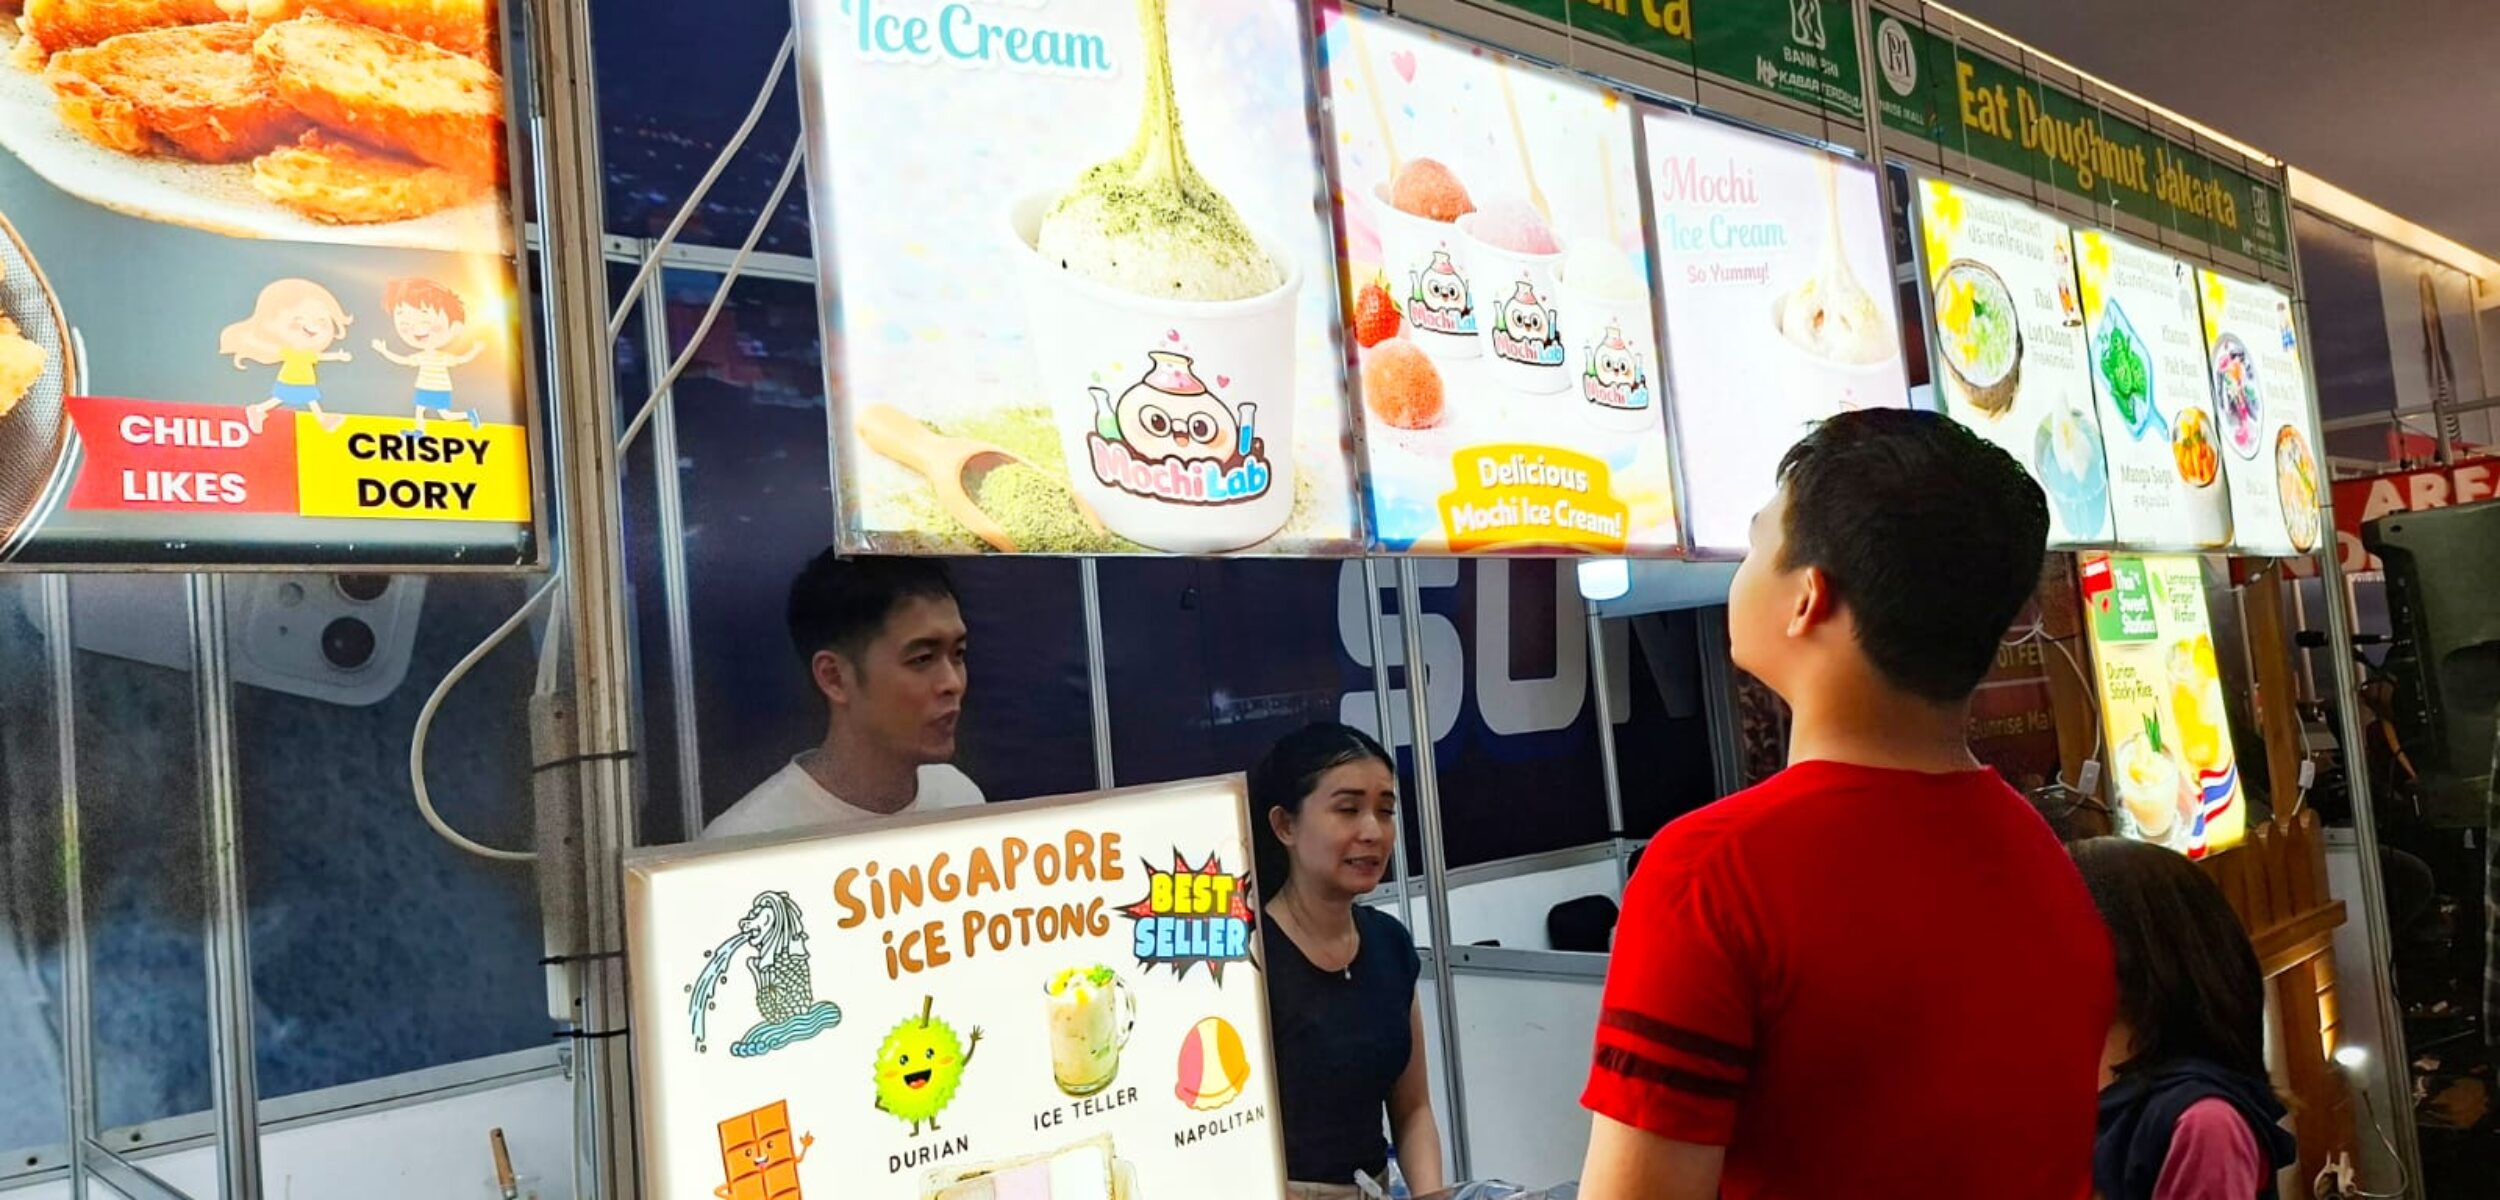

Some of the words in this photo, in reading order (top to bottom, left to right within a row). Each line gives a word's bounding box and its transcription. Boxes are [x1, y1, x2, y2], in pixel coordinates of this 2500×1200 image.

[841, 0, 931, 54] Ice
[939, 4, 1111, 70] Cream
[1783, 46, 1818, 70] BANK
[1957, 60, 2013, 140] Eat
[2016, 86, 2149, 191] Doughnut
[2155, 147, 2238, 230] Jakarta
[1662, 155, 1758, 203] Mochi
[1663, 211, 1703, 250] Ice
[1709, 213, 1788, 249] Cream
[1687, 264, 1707, 284] So
[1709, 262, 1770, 286] Yummy!
[119, 414, 249, 449] CHILD
[347, 433, 491, 465] CRISPY
[121, 469, 247, 504] LIKES
[1477, 454, 1589, 494] Delicious
[357, 479, 478, 511] DORY
[1451, 497, 1517, 535] Mochi
[1522, 501, 1552, 528] Ice
[1554, 500, 1622, 538] Cream!
[1149, 873, 1237, 915] BEST
[964, 898, 1110, 959] POTONG
[1134, 917, 1249, 963] SELLER
[1033, 1110, 1067, 1132] ICE
[1070, 1087, 1139, 1122] TELLER
[1174, 1105, 1266, 1149] NAPOLITAN
[888, 1135, 970, 1174] DURIAN
